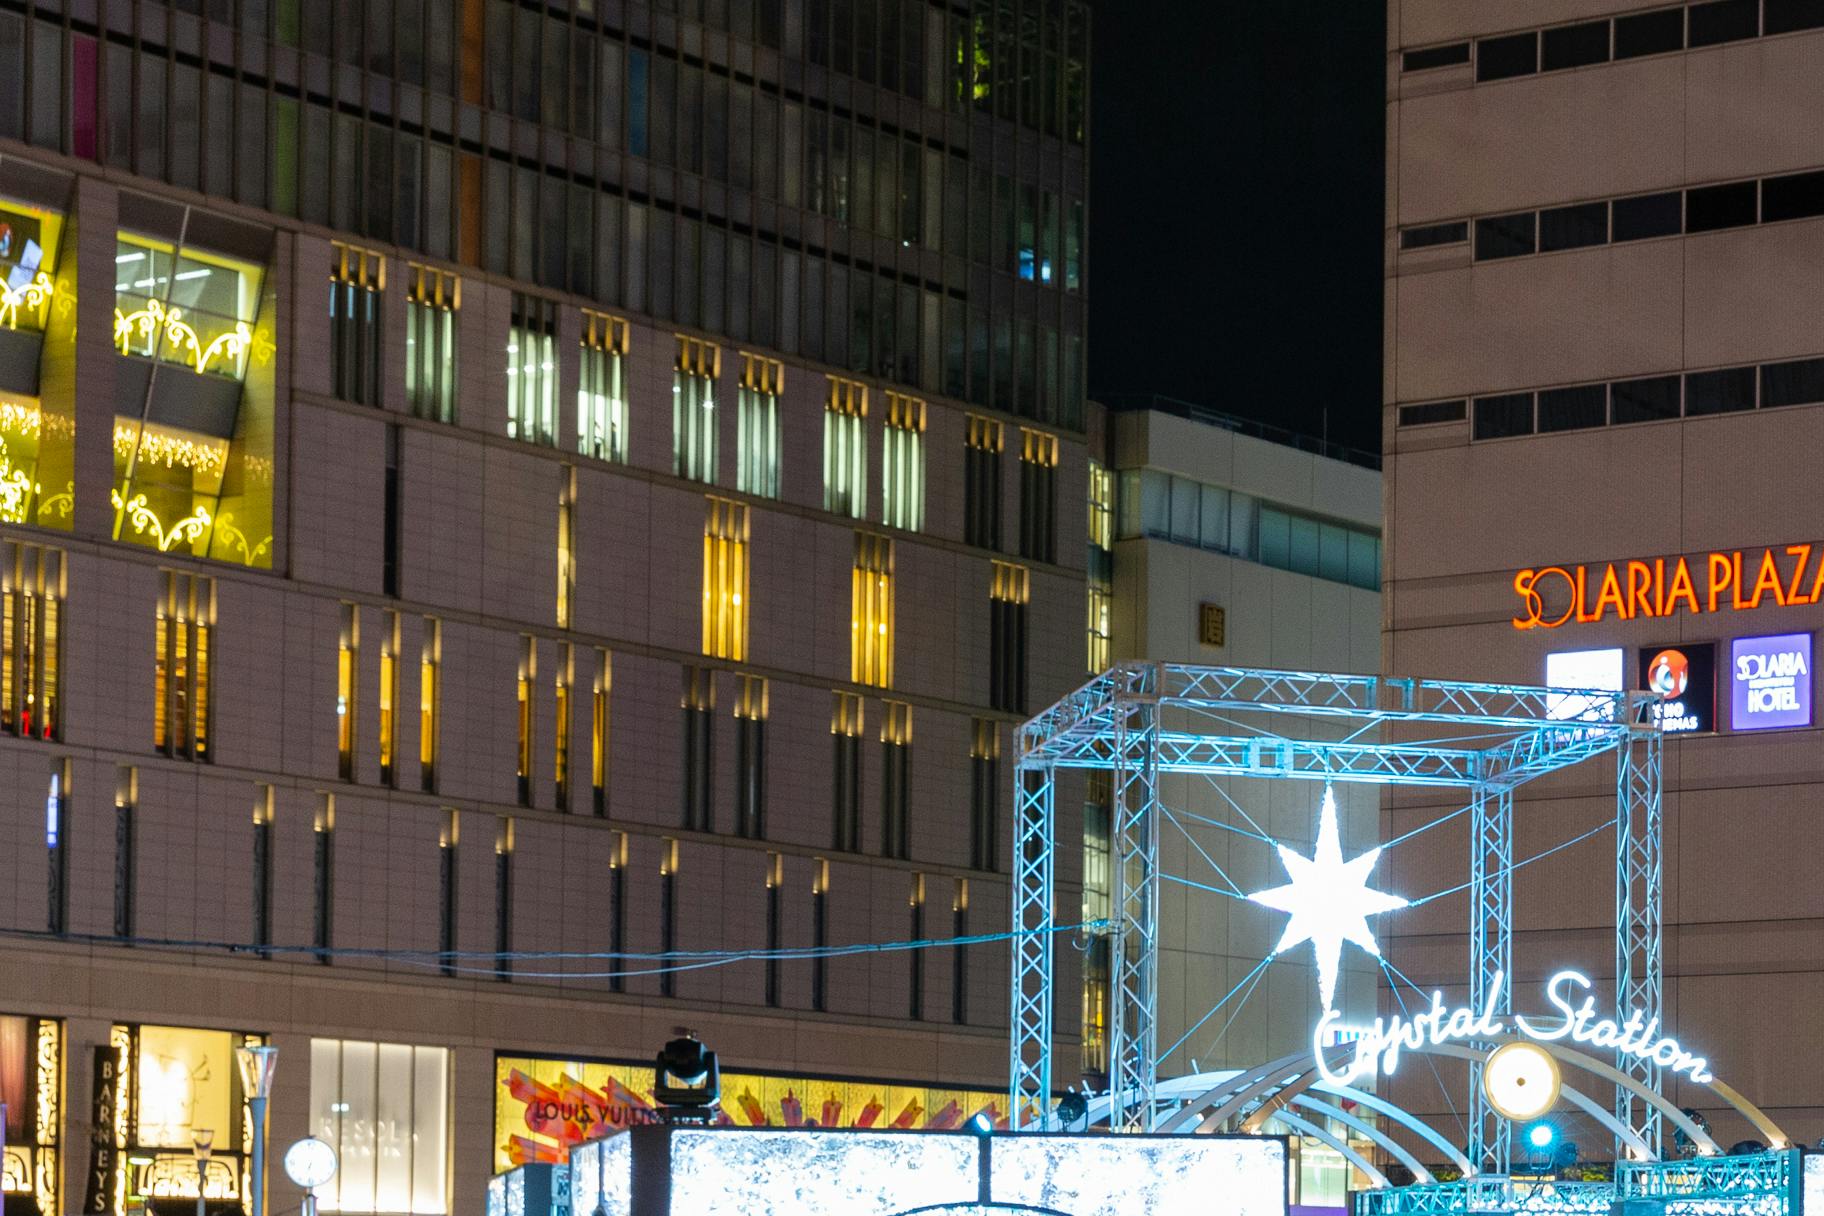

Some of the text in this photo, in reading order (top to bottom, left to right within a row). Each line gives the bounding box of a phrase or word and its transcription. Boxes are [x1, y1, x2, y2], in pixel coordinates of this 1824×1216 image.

[1512, 556, 1700, 630] SOLARIA
[1736, 651, 1808, 681] SOLARIA
[1747, 686, 1801, 714] HOTEL
[1314, 969, 1714, 1087] Crystal Station
[94, 1060, 113, 1212] BARNEYS
[536, 1101, 665, 1125] LOUIS VUITTO
